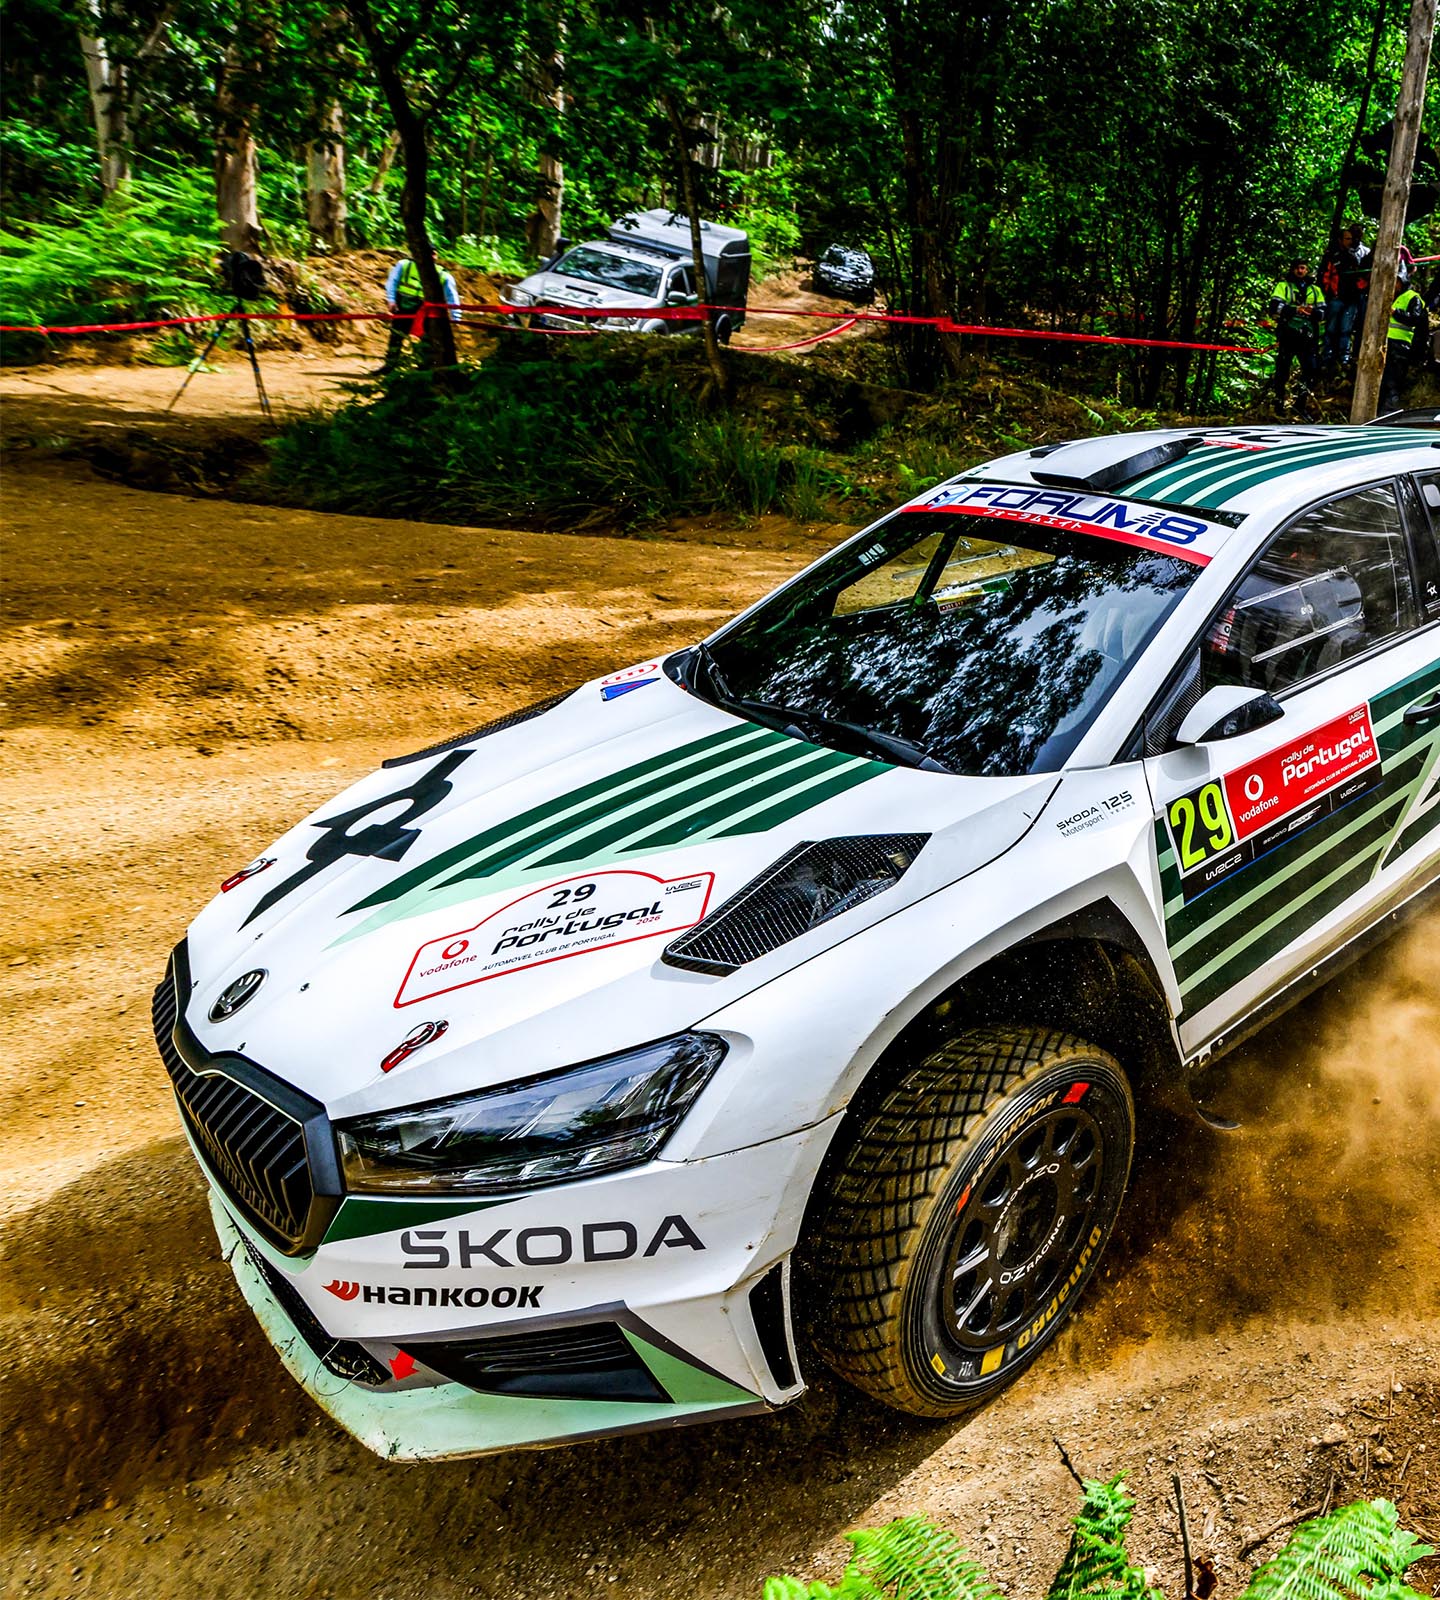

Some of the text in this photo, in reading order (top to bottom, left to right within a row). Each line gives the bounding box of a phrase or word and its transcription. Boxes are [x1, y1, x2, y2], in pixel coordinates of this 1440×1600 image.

[958, 486, 1209, 545] FORUM8
[983, 508, 1083, 530] フォーラムエイト
[1281, 744, 1315, 767] rally de
[1282, 725, 1370, 787] Portugal
[1357, 748, 1374, 762] 2026
[1101, 790, 1133, 811] 125
[1238, 795, 1280, 824] vodafone
[1061, 813, 1105, 838] Motorsport
[1169, 782, 1232, 870] 29
[1205, 852, 1243, 881] WRC2
[546, 883, 597, 910] 29
[490, 900, 665, 956] Portugal
[501, 907, 597, 938] rally de
[636, 915, 662, 926] 2026
[534, 947, 558, 957] CLUB
[558, 942, 572, 951] DE
[571, 932, 617, 948] PORTUGAL
[419, 952, 478, 978] vodafone
[400, 1213, 707, 1270] SKODA
